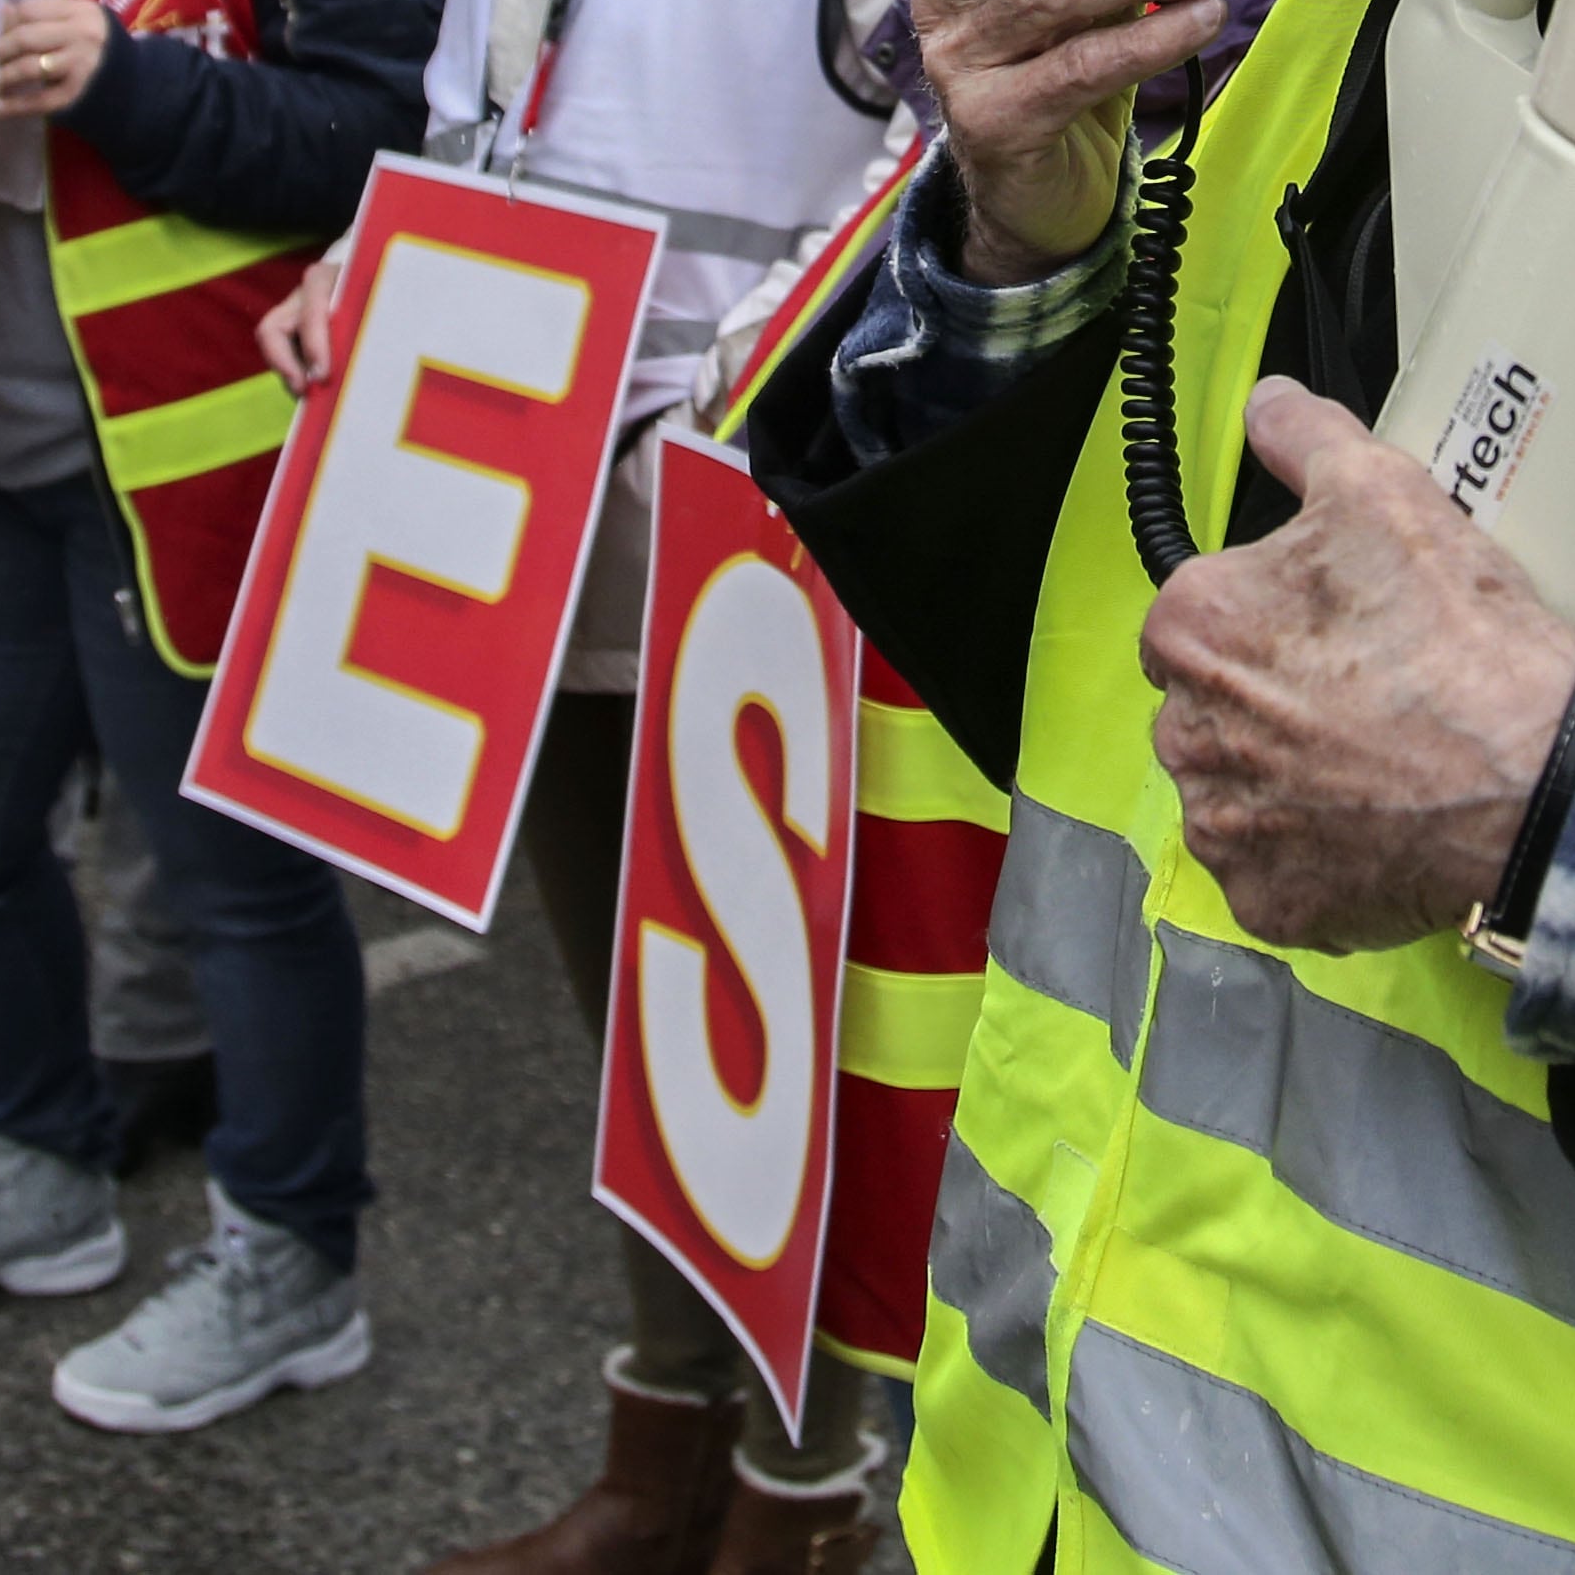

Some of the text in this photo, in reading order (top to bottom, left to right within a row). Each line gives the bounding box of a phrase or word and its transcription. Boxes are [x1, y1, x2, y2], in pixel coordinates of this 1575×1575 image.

[1450, 363, 1537, 518] rtech
[242, 231, 592, 843] E
[637, 550, 828, 1271] S
